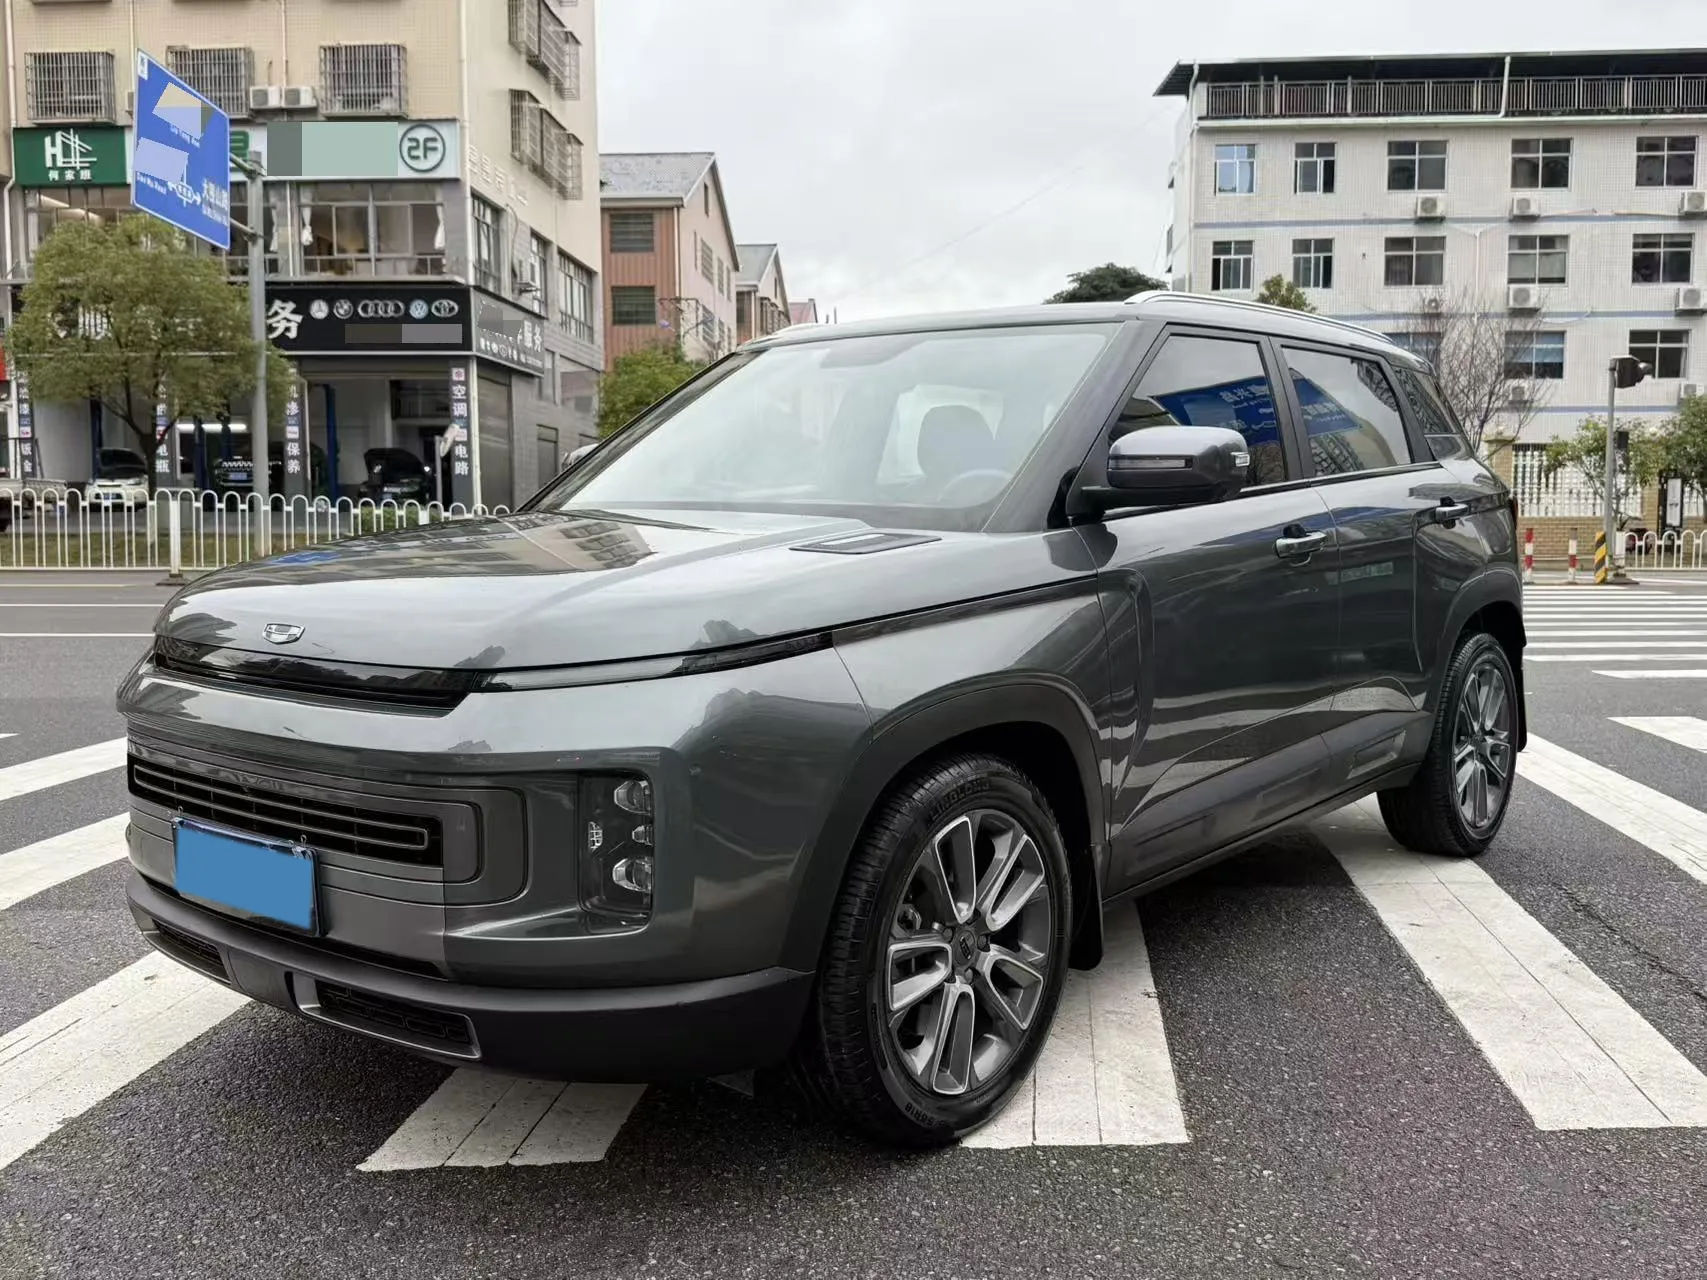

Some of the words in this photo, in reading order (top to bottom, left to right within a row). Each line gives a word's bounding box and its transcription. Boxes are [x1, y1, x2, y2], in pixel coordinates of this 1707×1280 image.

[406, 136, 438, 161] 2F
[267, 299, 303, 340] 务
[452, 384, 468, 417] 空调
[287, 442, 301, 473] 保养
[454, 444, 469, 475] 电路
